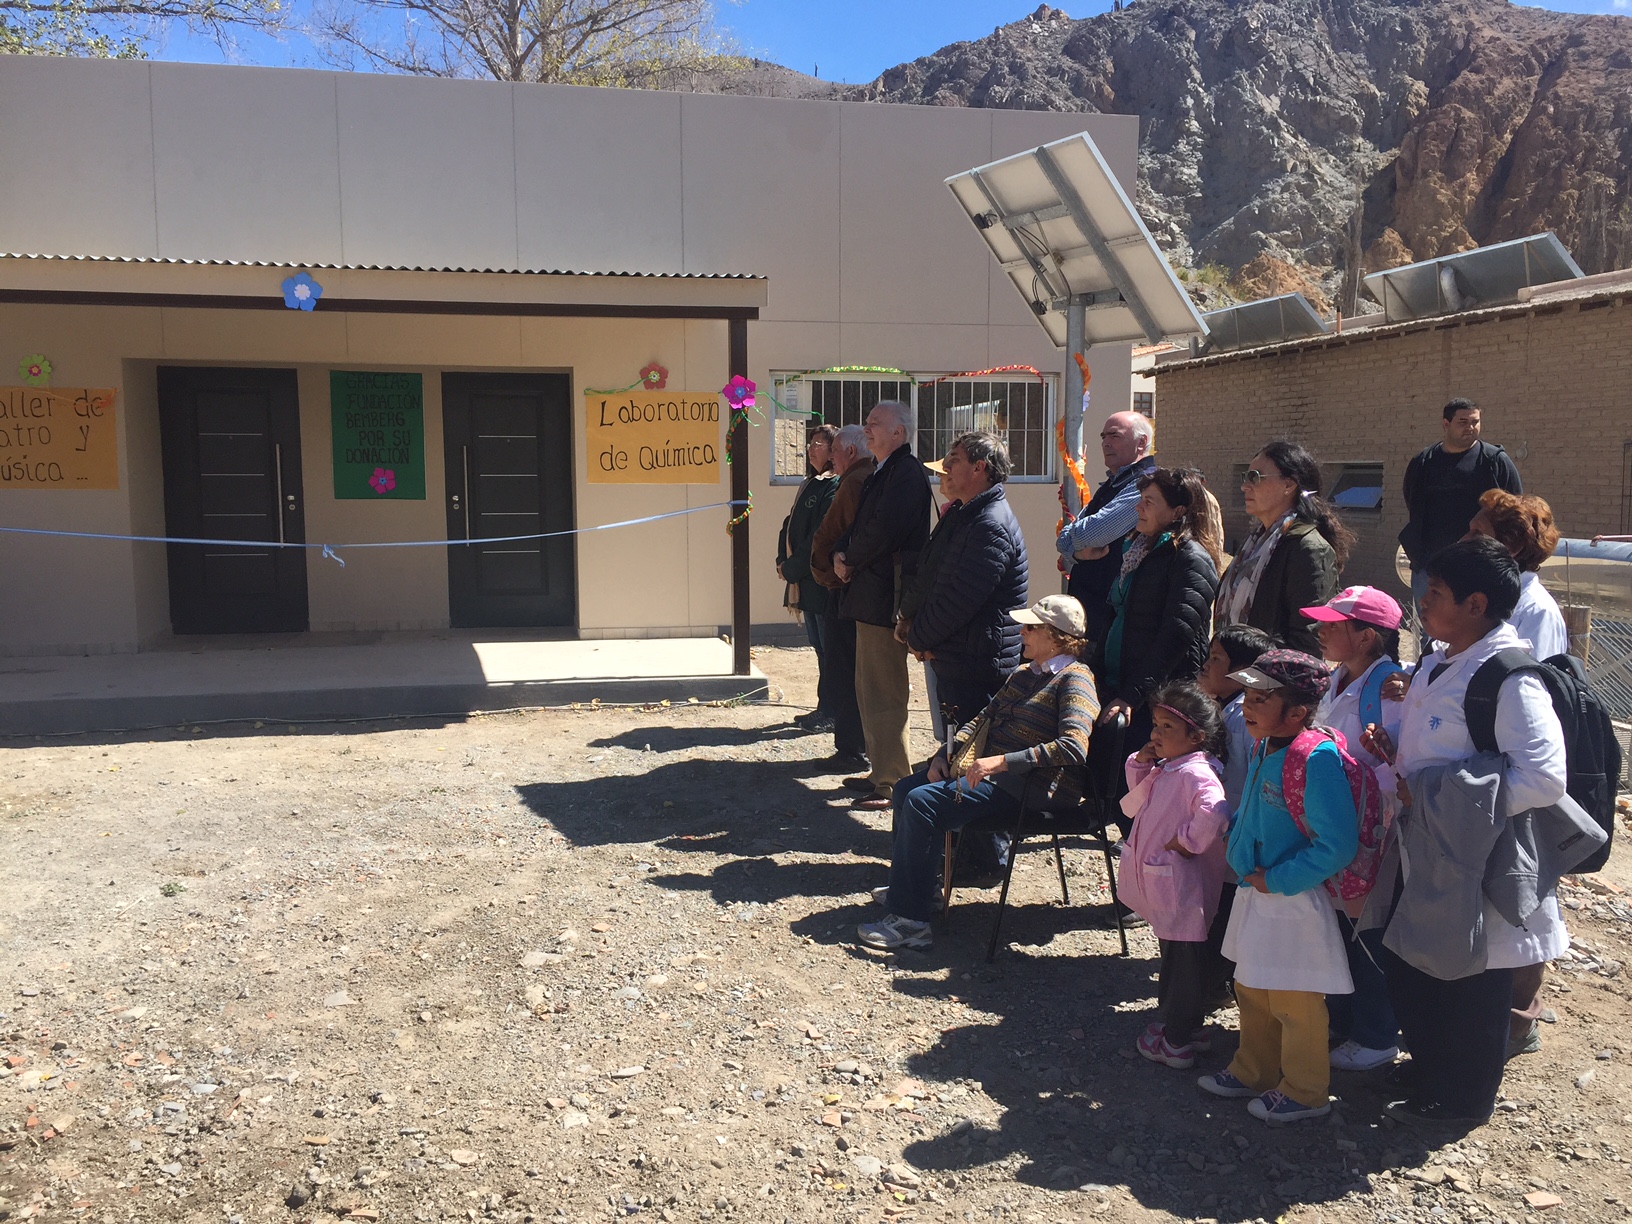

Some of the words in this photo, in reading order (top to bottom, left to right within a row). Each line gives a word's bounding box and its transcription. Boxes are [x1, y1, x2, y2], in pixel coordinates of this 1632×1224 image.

[345, 374, 410, 390] GRACIAS
[73, 389, 104, 418] de
[345, 411, 406, 429] BEMBERG
[75, 424, 90, 452] y
[359, 430, 385, 447] POR
[392, 429, 411, 448] SU
[599, 444, 629, 472] de
[638, 439, 718, 471] Química
